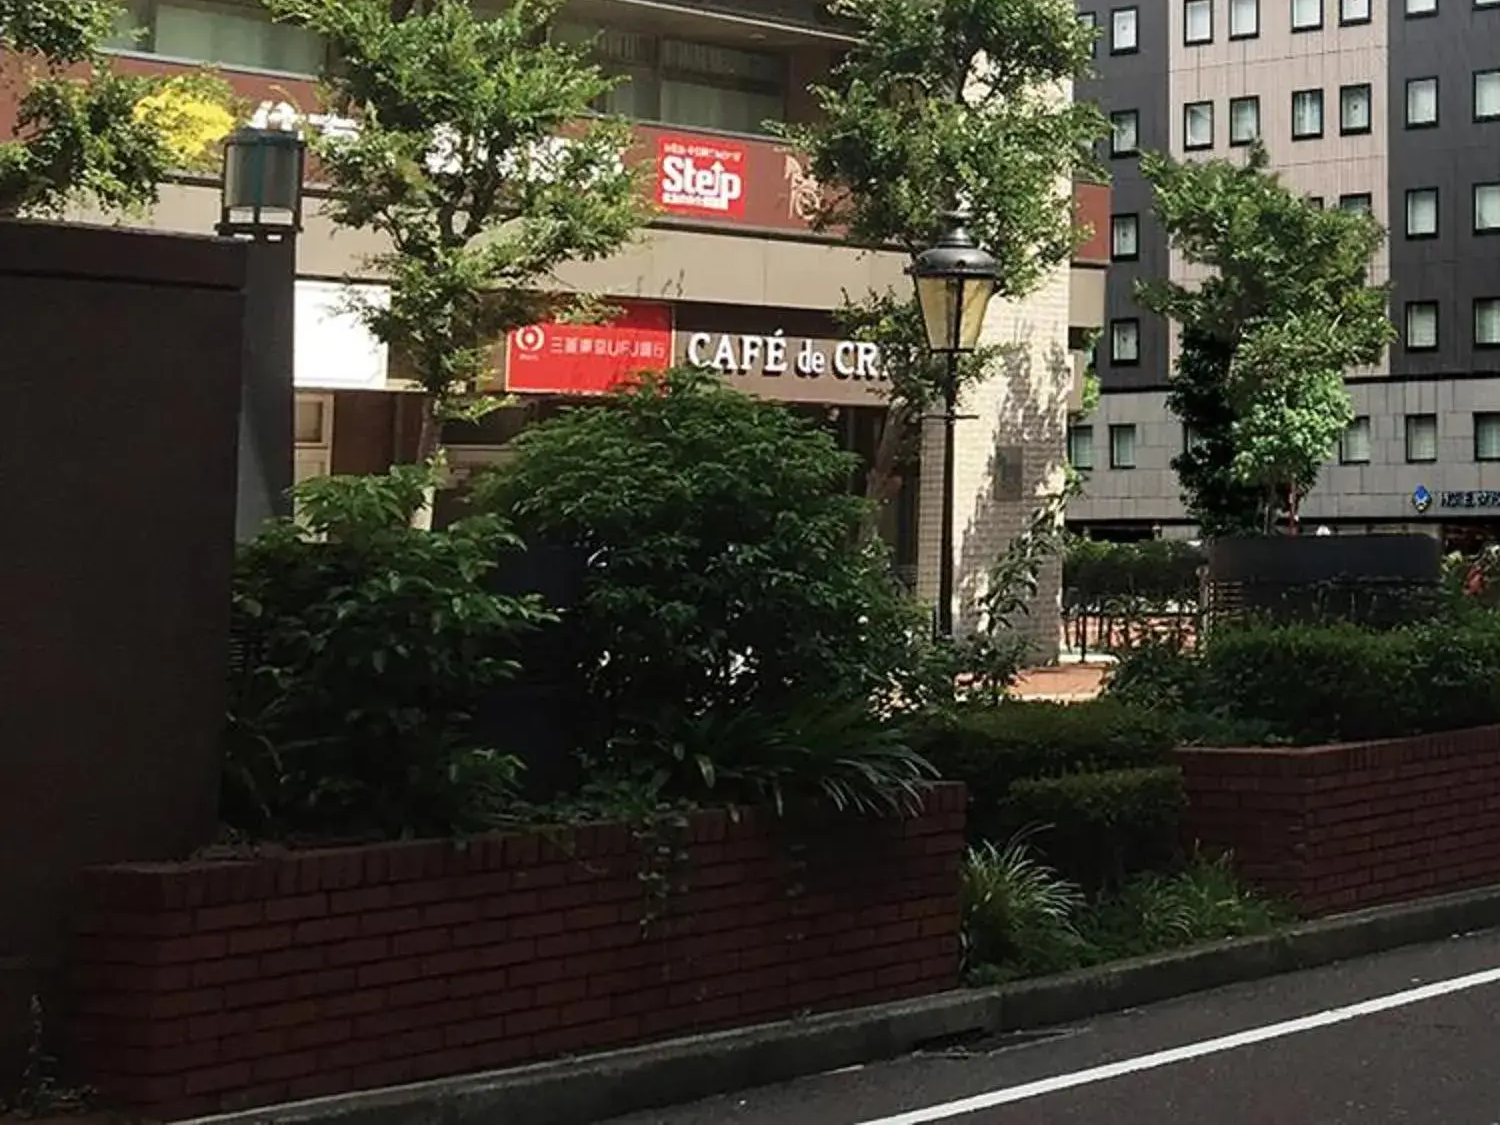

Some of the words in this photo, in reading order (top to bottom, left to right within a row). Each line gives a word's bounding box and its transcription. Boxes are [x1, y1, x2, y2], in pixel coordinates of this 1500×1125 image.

[662, 155, 741, 203] Step
[687, 329, 789, 372] CAFÉ
[797, 338, 826, 373] de
